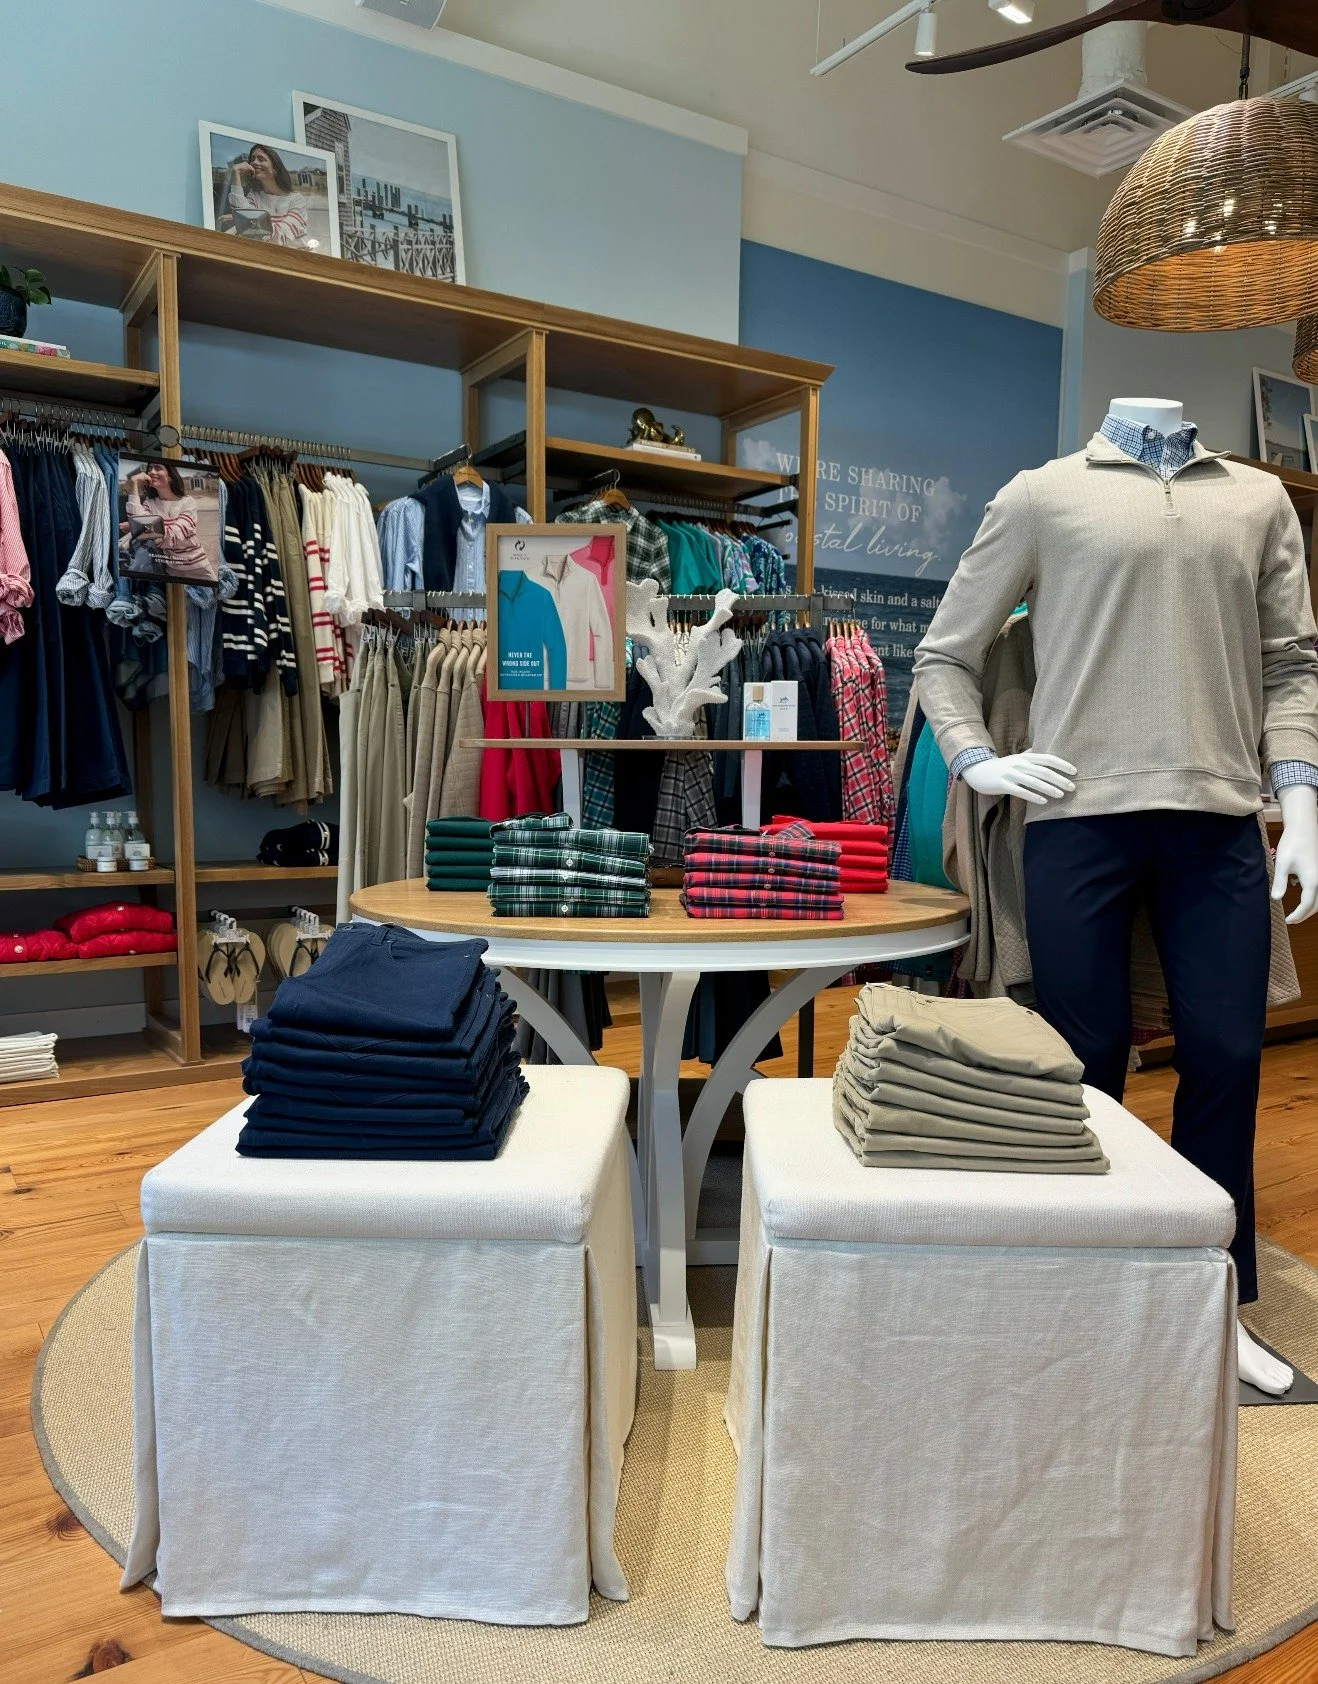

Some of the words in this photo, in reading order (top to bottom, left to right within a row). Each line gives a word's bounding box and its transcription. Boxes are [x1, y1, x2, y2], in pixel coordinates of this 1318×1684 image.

[847, 465, 936, 497] SHARING
[824, 491, 891, 519] SPIRIT
[897, 503, 922, 523] OF
[860, 589, 885, 604] skin
[887, 592, 908, 606] and
[911, 598, 918, 607] a
[920, 595, 941, 609] salt
[871, 616, 887, 630] for
[890, 618, 917, 633] what
[892, 643, 913, 658] like
